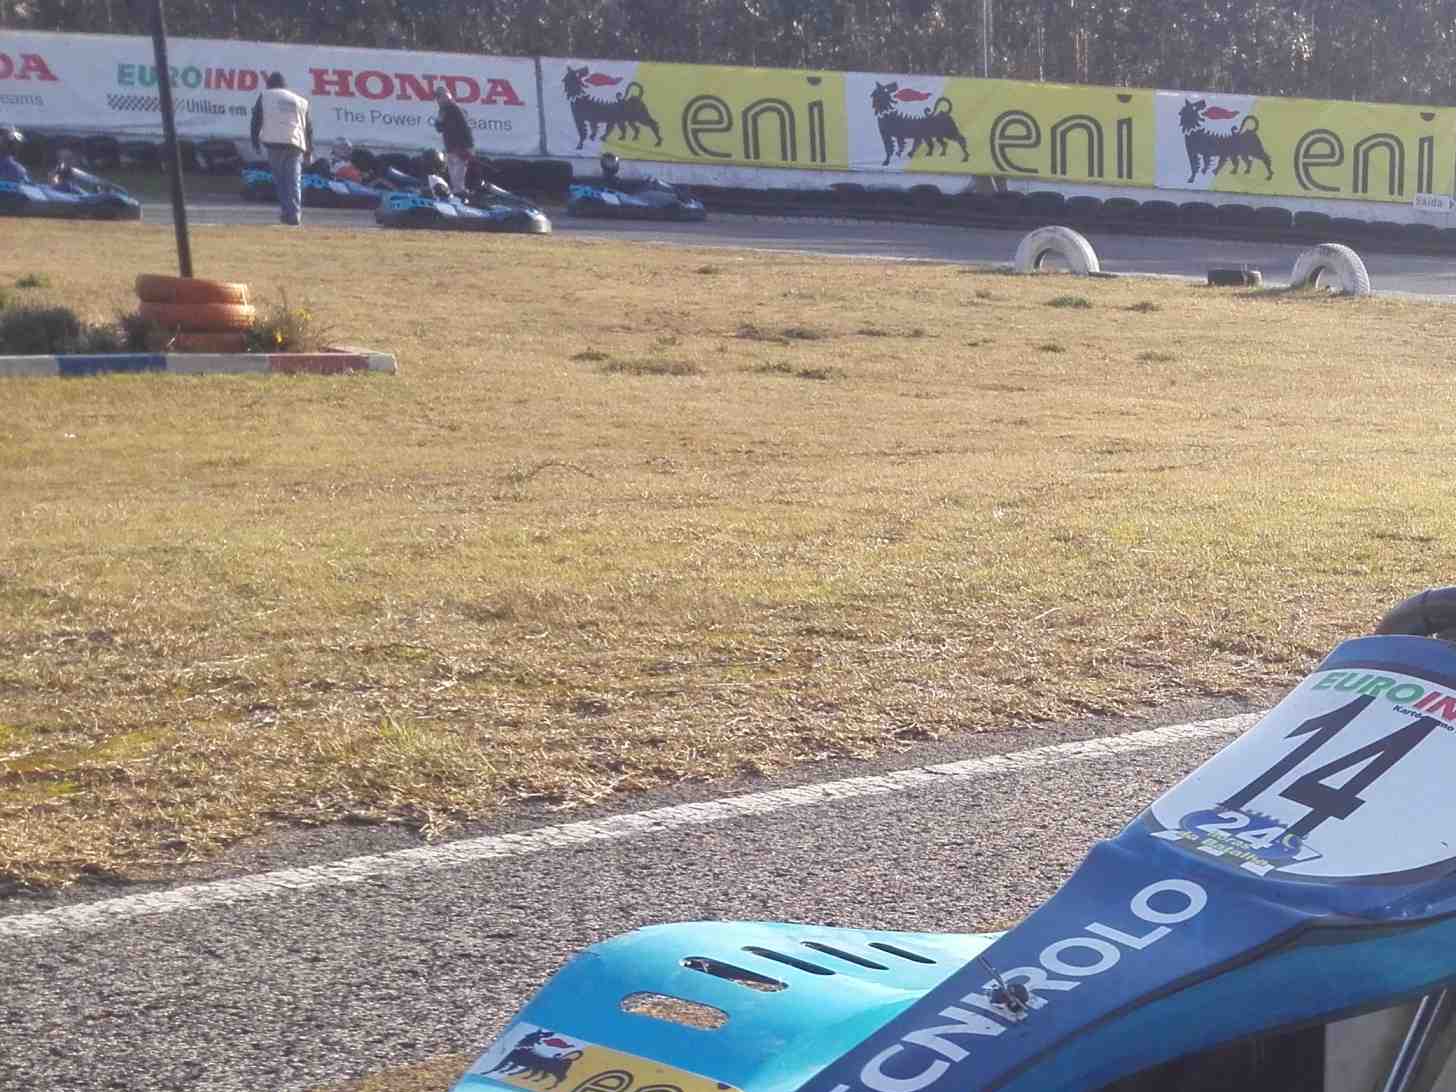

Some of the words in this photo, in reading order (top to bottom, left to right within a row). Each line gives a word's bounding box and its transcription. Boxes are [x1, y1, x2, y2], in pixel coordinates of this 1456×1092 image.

[308, 67, 525, 106] HONDA
[333, 107, 365, 124] The
[370, 108, 422, 127] Power
[681, 76, 827, 163] eni
[990, 94, 1133, 179] eni
[1294, 112, 1436, 197] eni
[1218, 694, 1443, 839] 14
[1196, 810, 1287, 850] 24
